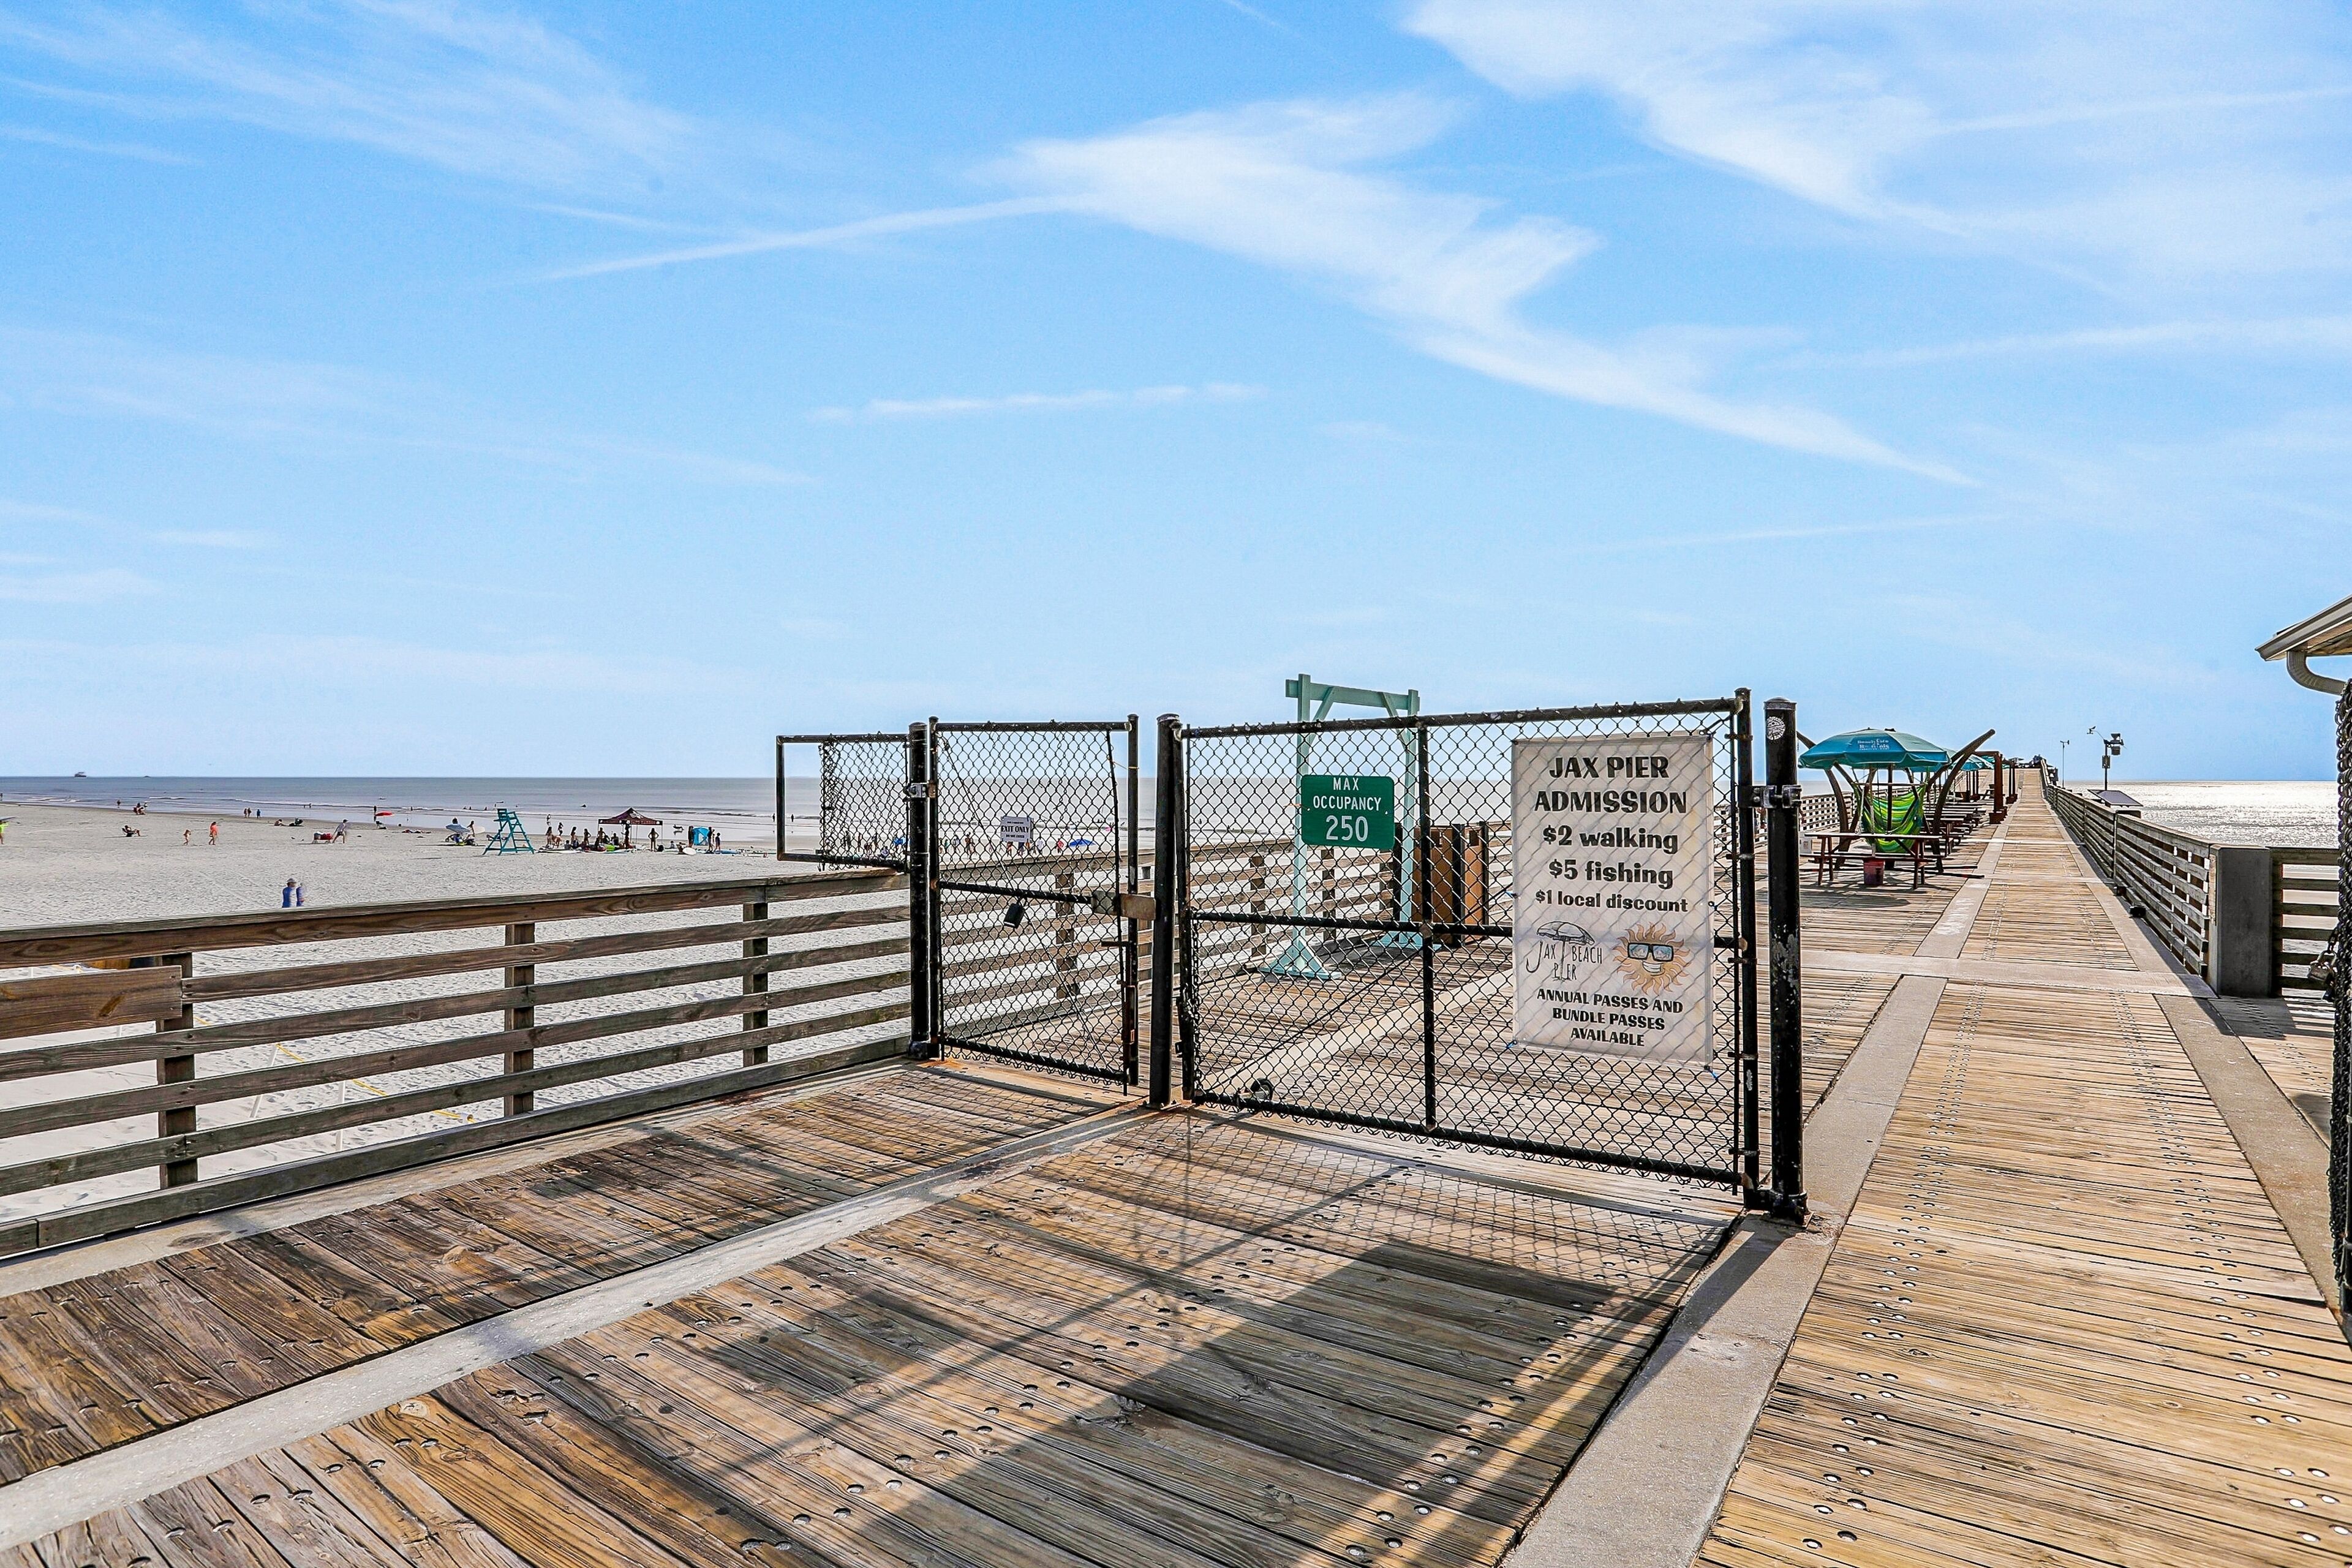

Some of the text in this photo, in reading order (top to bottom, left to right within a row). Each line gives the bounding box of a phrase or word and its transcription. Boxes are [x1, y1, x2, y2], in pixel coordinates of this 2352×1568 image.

[1549, 756, 1669, 779] JAX PIER
[1333, 777, 1359, 791] MAX
[1313, 796, 1381, 811] OCCUPANCY
[1534, 791, 1686, 813] ADMISSION
[1325, 815, 1368, 842] 250
[1543, 824, 1678, 854] $2 walking
[1549, 859, 1673, 889] $5 fishing
[1536, 889, 1688, 912] $1 local discount
[1526, 940, 1602, 973] JAX BEACH
[1537, 988, 1683, 1013] ANNUAL PASSES AND
[1553, 1008, 1665, 1030] BUNDLE PASSES
[1570, 1028, 1644, 1047] AVAILABLE
